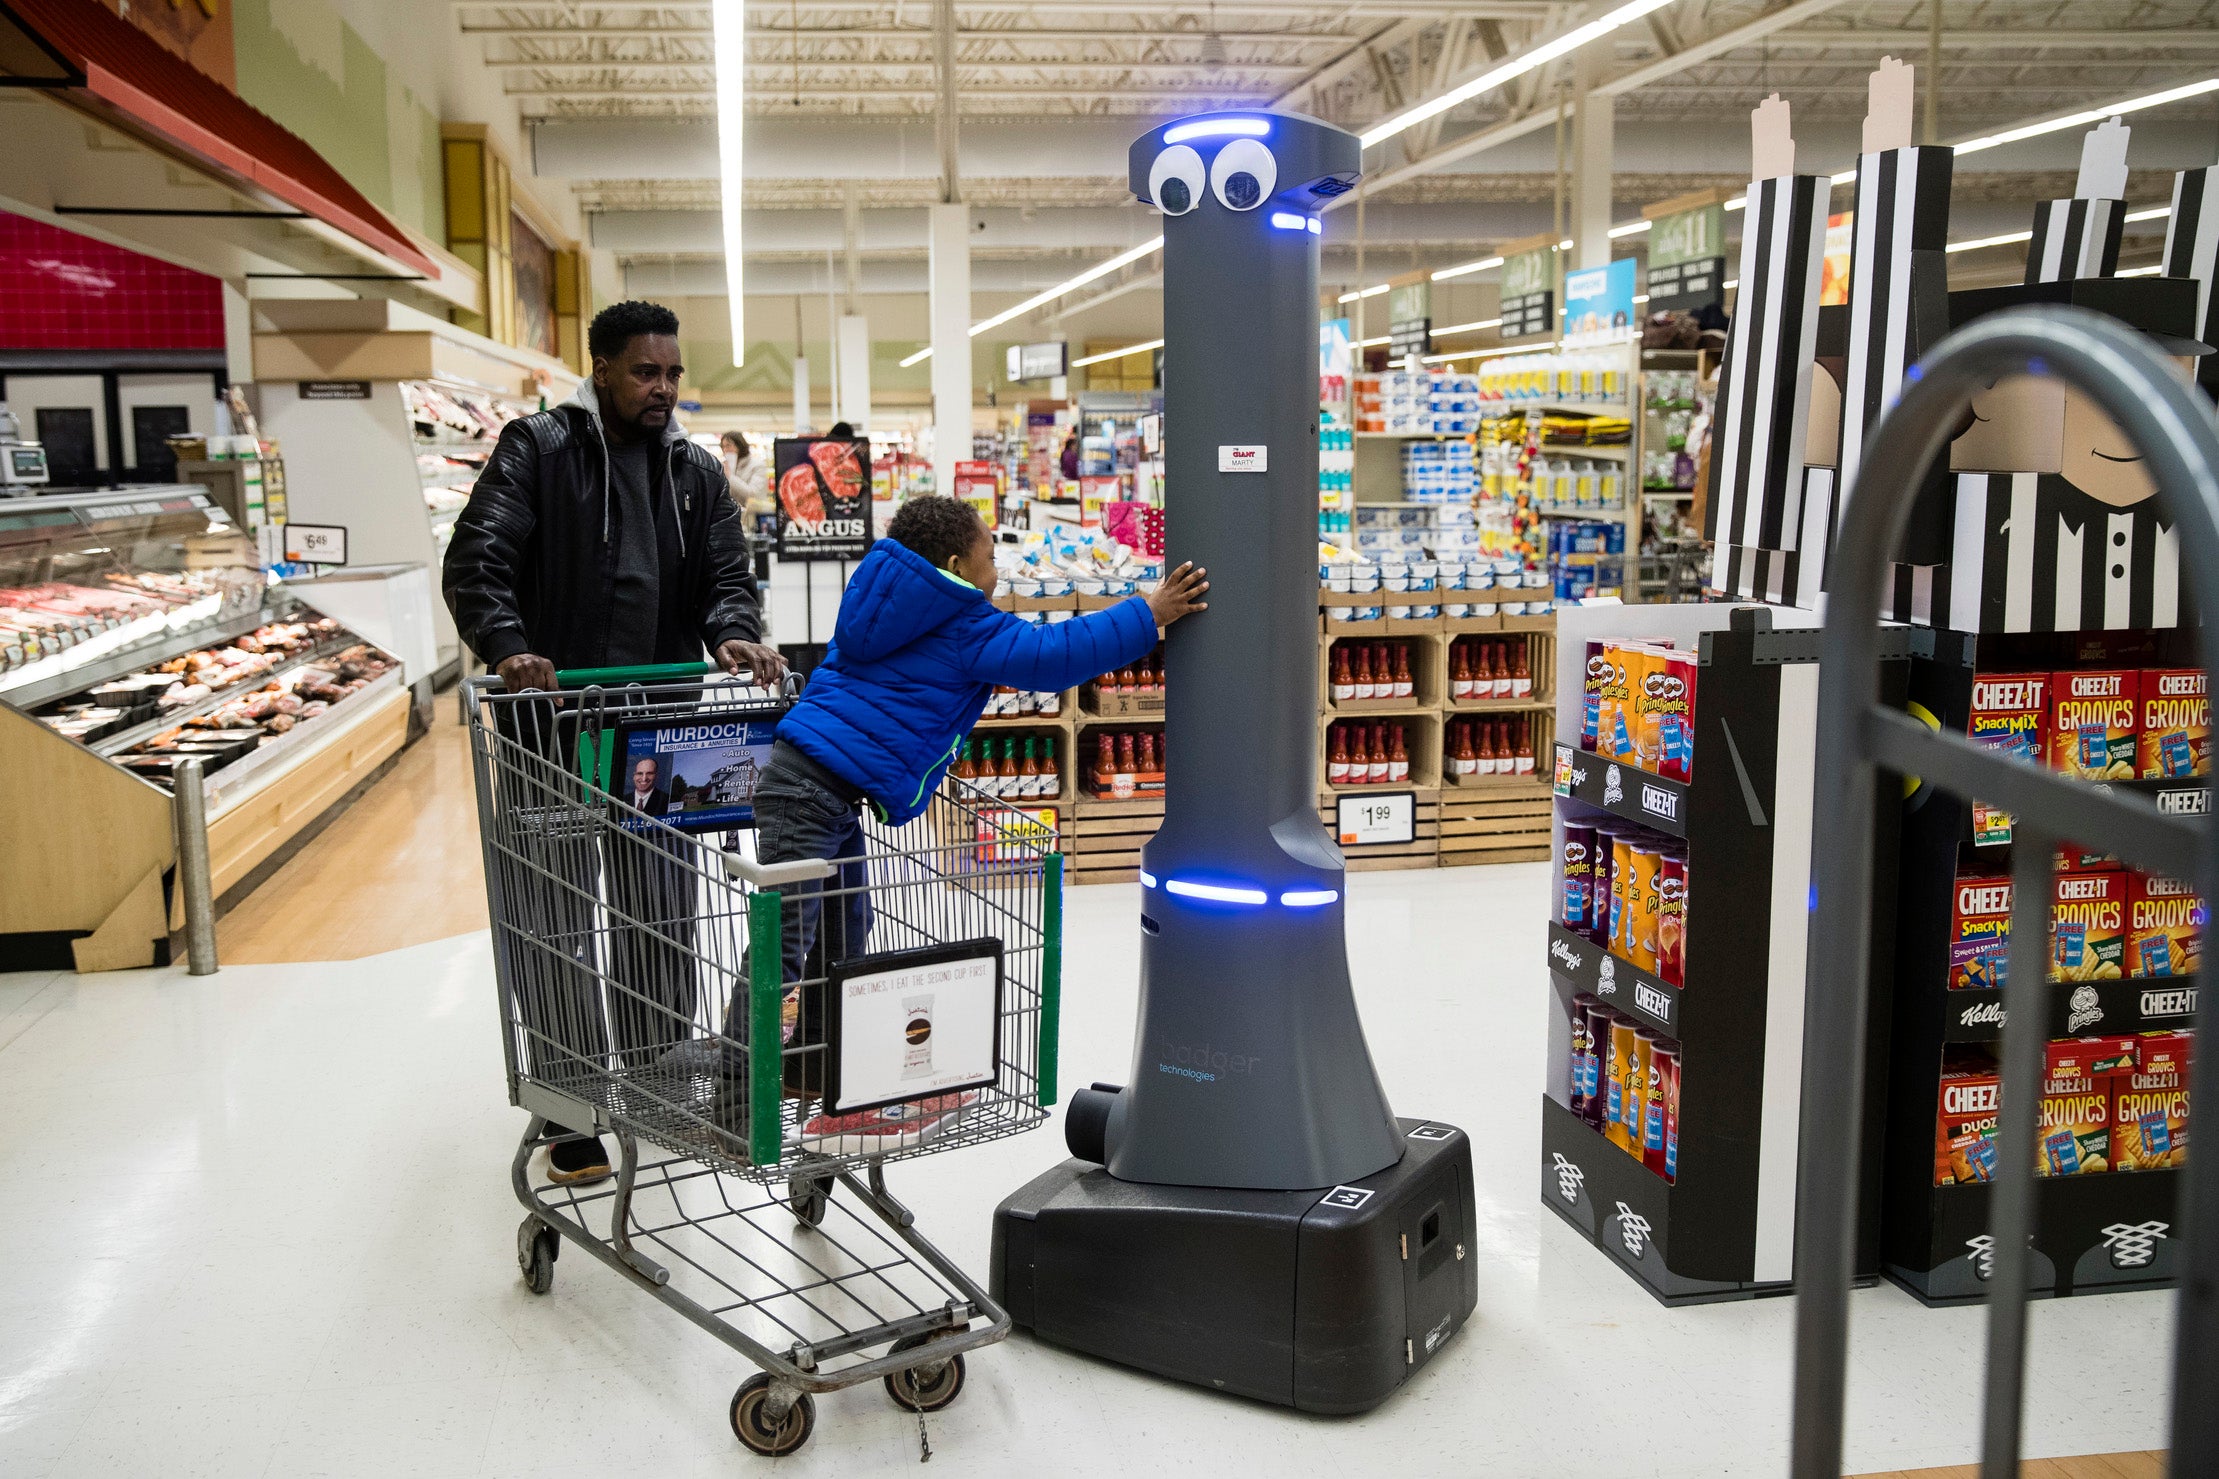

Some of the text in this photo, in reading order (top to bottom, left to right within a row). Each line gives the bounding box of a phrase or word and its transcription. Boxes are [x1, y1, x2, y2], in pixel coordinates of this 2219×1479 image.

[784, 519, 866, 537] ANGUS
[1585, 677, 1603, 692] Pring
[1640, 697, 1665, 717] Pring
[1974, 716, 2010, 733] Snack
[2080, 725, 2105, 735] FREE
[655, 722, 748, 751] MURDOCH
[2001, 734, 2024, 751] FREE
[2162, 734, 2186, 747] FREE
[663, 742, 698, 751] INSURANCE
[708, 738, 739, 747] ANNUITIES
[728, 749, 750, 757] Auto
[2112, 749, 2134, 760] CHEDDAR
[726, 764, 753, 772] Home
[722, 795, 740, 803] Life
[1660, 898, 1682, 916] Pringl
[1959, 886, 2012, 915] CHEEZ-
[1962, 920, 1995, 937] Snack
[2058, 925, 2083, 934] FREE
[2141, 937, 2165, 950] FREE
[1552, 939, 1582, 970] Kellogg's
[1987, 948, 2008, 957] FREE
[2099, 949, 2121, 960] CHEDDAR
[896, 978, 908, 989] EAT
[912, 975, 924, 986] THE
[927, 971, 952, 984] SECOND
[954, 967, 966, 980] CUP
[1960, 1002, 2008, 1028] Kellog
[2069, 1008, 2103, 1031] Pringles
[1160, 1063, 1215, 1082] technologies
[1961, 1116, 1998, 1134] DUOZ
[2141, 1113, 2164, 1125] FREE
[1951, 1139, 1977, 1149] CHEDDAR
[1954, 1135, 1972, 1143] SHARP
[2047, 1134, 2071, 1146] FREE
[1967, 1140, 1991, 1157] FREE
[2085, 1143, 2107, 1153] CHEDDAR
